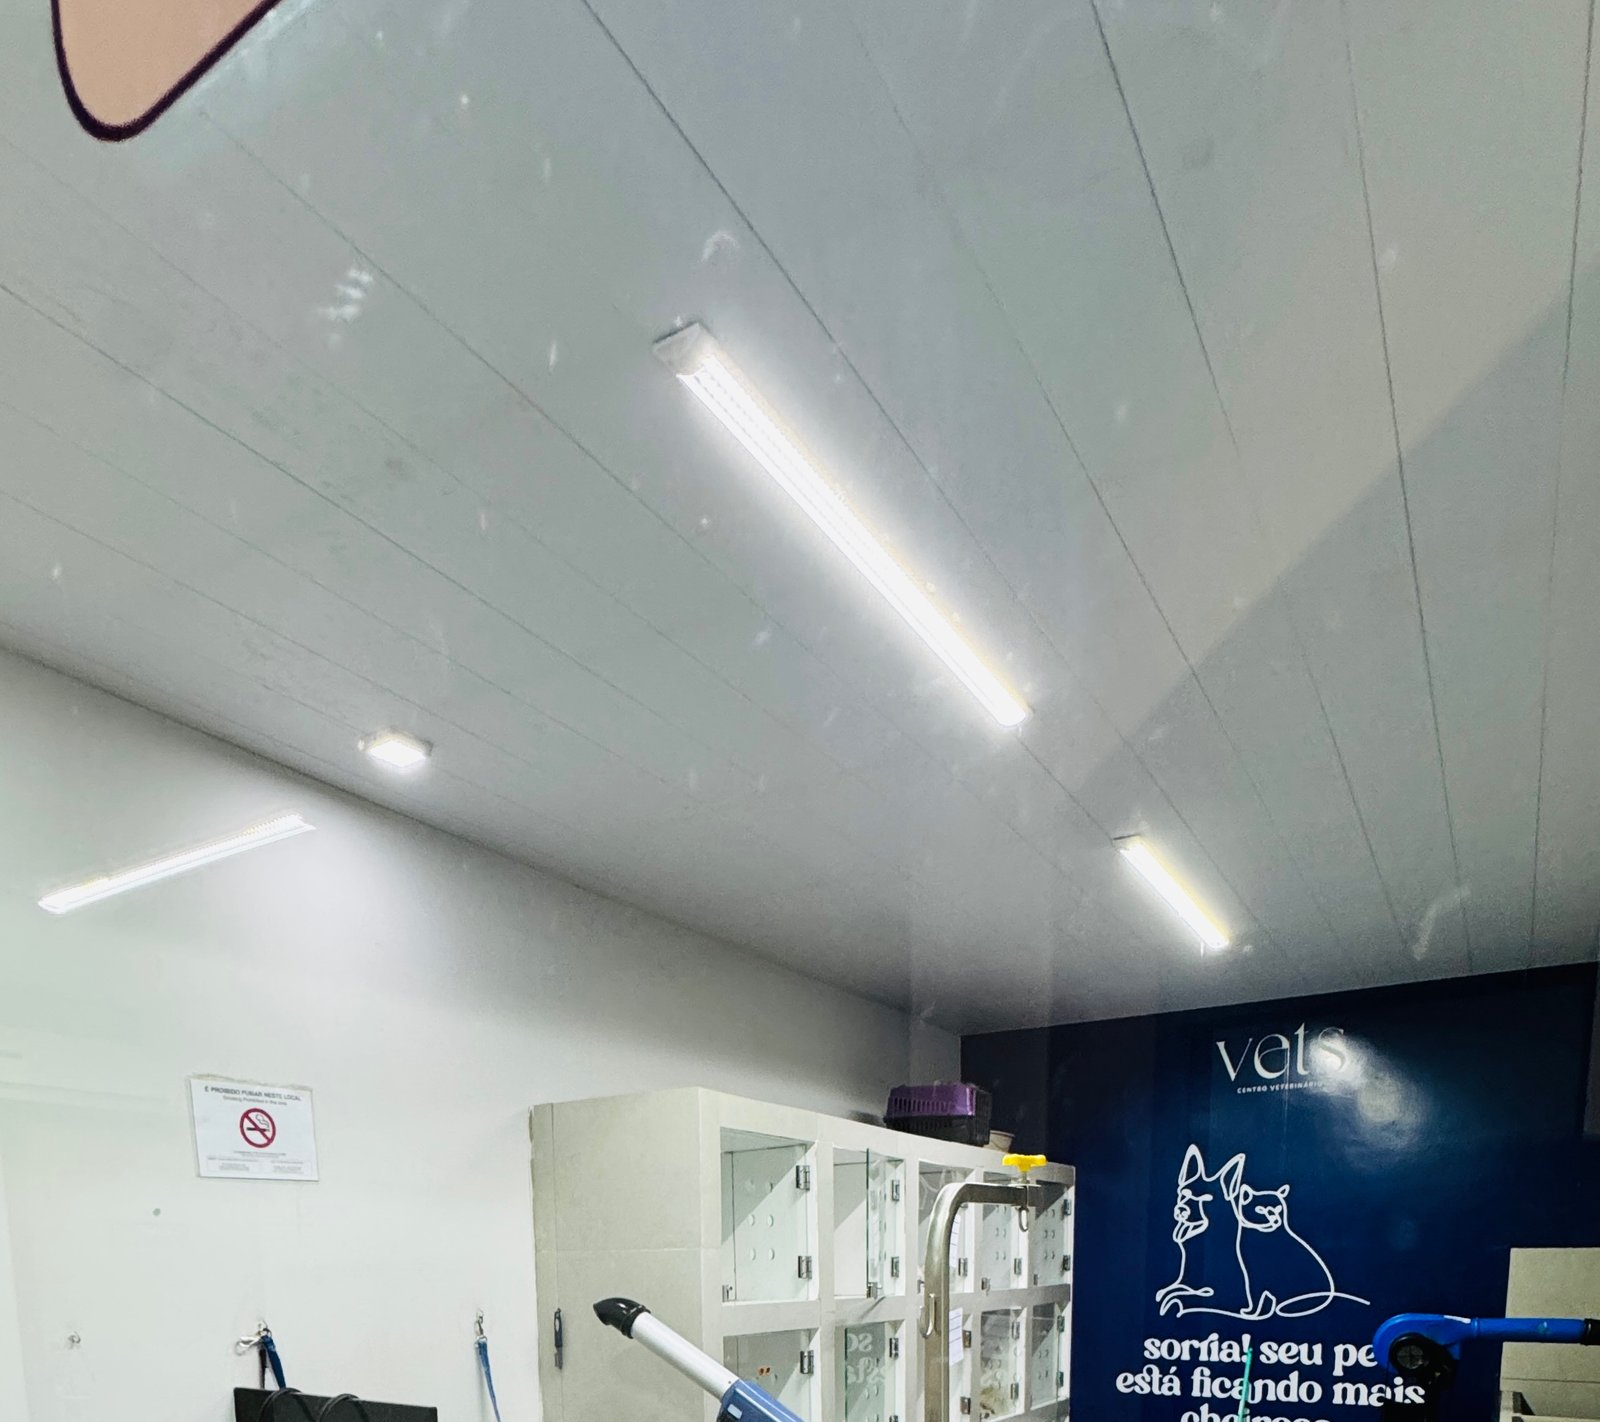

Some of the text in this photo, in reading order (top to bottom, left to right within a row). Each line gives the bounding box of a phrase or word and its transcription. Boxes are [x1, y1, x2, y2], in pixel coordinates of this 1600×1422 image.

[1216, 1022, 1346, 1082] vets
[1236, 1085, 1268, 1094] CENTRO
[1259, 1341, 1323, 1366] seu
[1332, 1343, 1378, 1377] pe
[1115, 1364, 1426, 1407] está ficando mais
